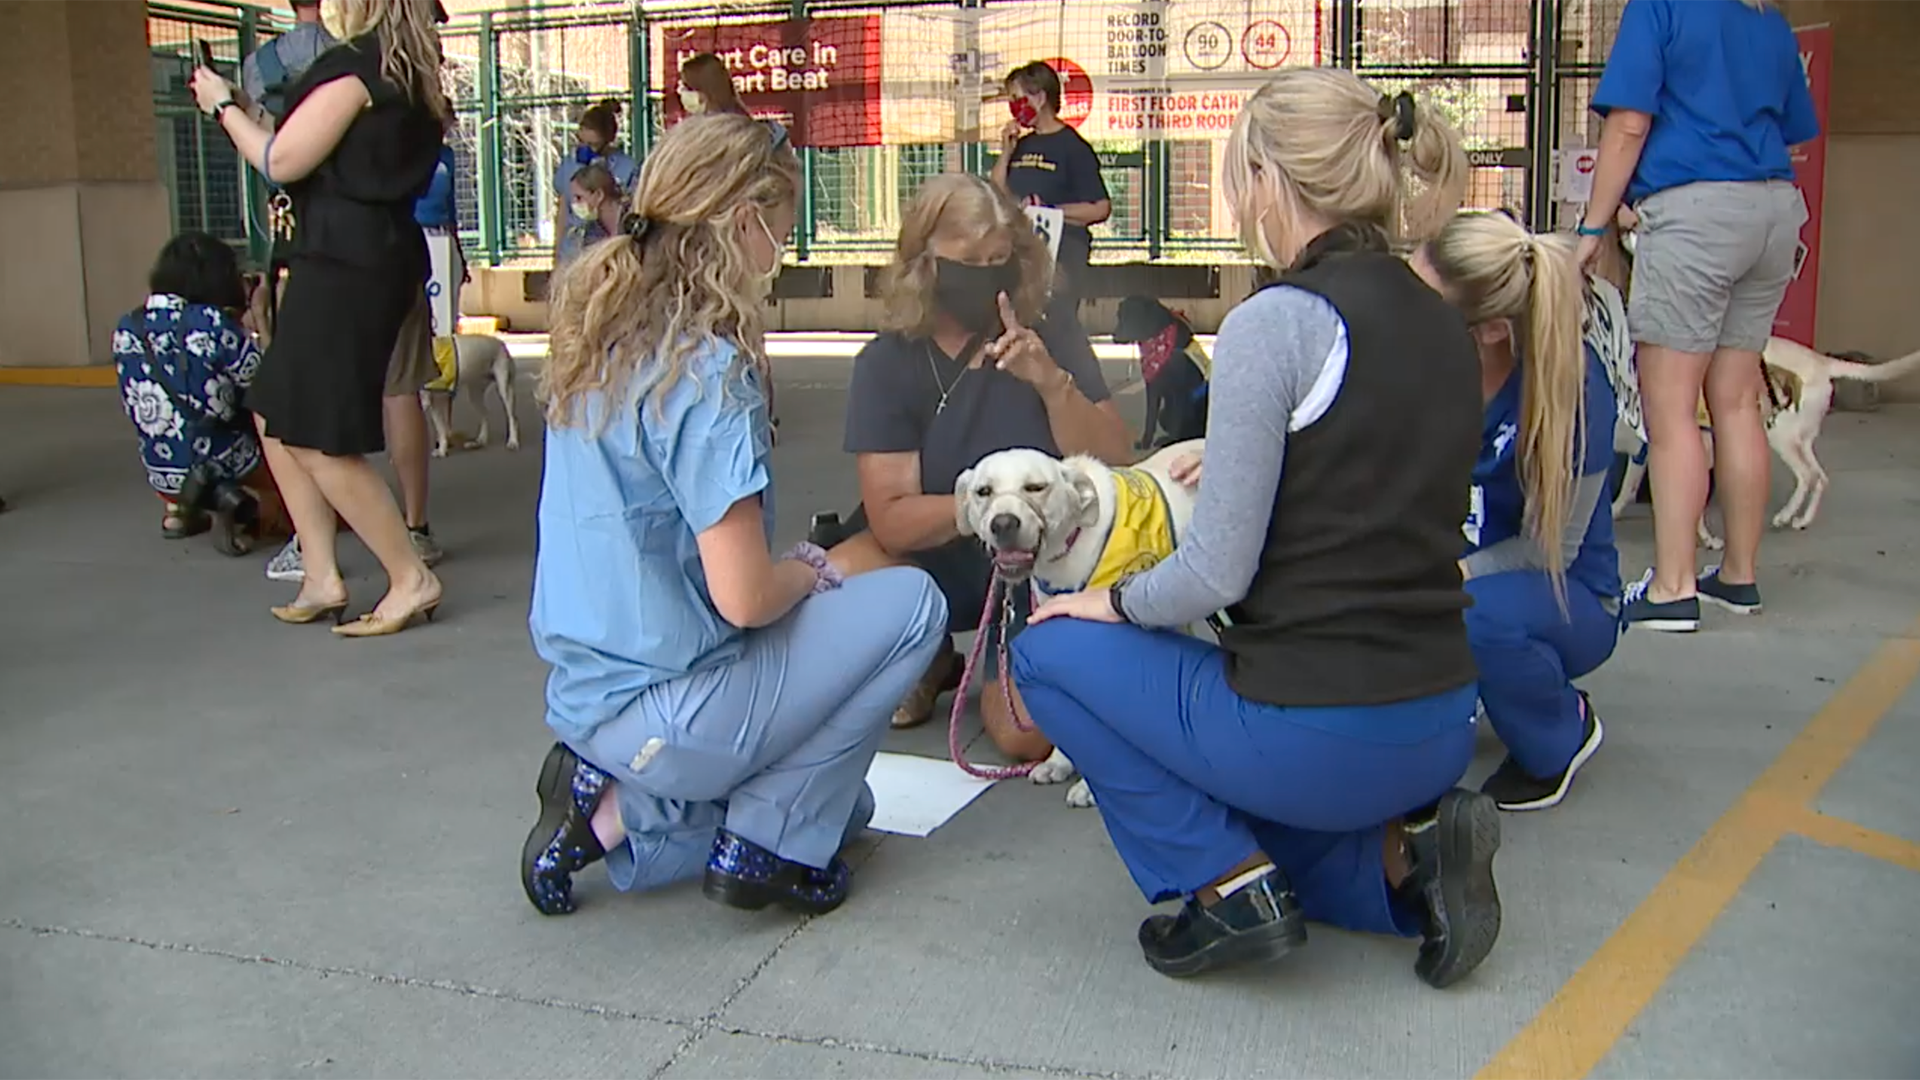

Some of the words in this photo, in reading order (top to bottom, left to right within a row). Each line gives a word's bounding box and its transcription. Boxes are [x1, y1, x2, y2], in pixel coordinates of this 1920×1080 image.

[1107, 13, 1159, 26] RECORD
[1198, 34, 1218, 50] 90
[1255, 33, 1275, 48] 44
[677, 48, 744, 72] Hrt
[750, 44, 806, 68] Care
[813, 41, 837, 64] in
[1107, 44, 1167, 58] BALLOON
[1107, 60, 1146, 73] TIMES
[770, 68, 829, 91] Beat
[1108, 97, 1146, 111] FIRST
[1150, 96, 1197, 111] FLOOR
[1201, 95, 1239, 110] CATH
[1108, 114, 1144, 129] PLUS
[1147, 114, 1192, 129] THIRD
[1470, 152, 1504, 165] ONLY
